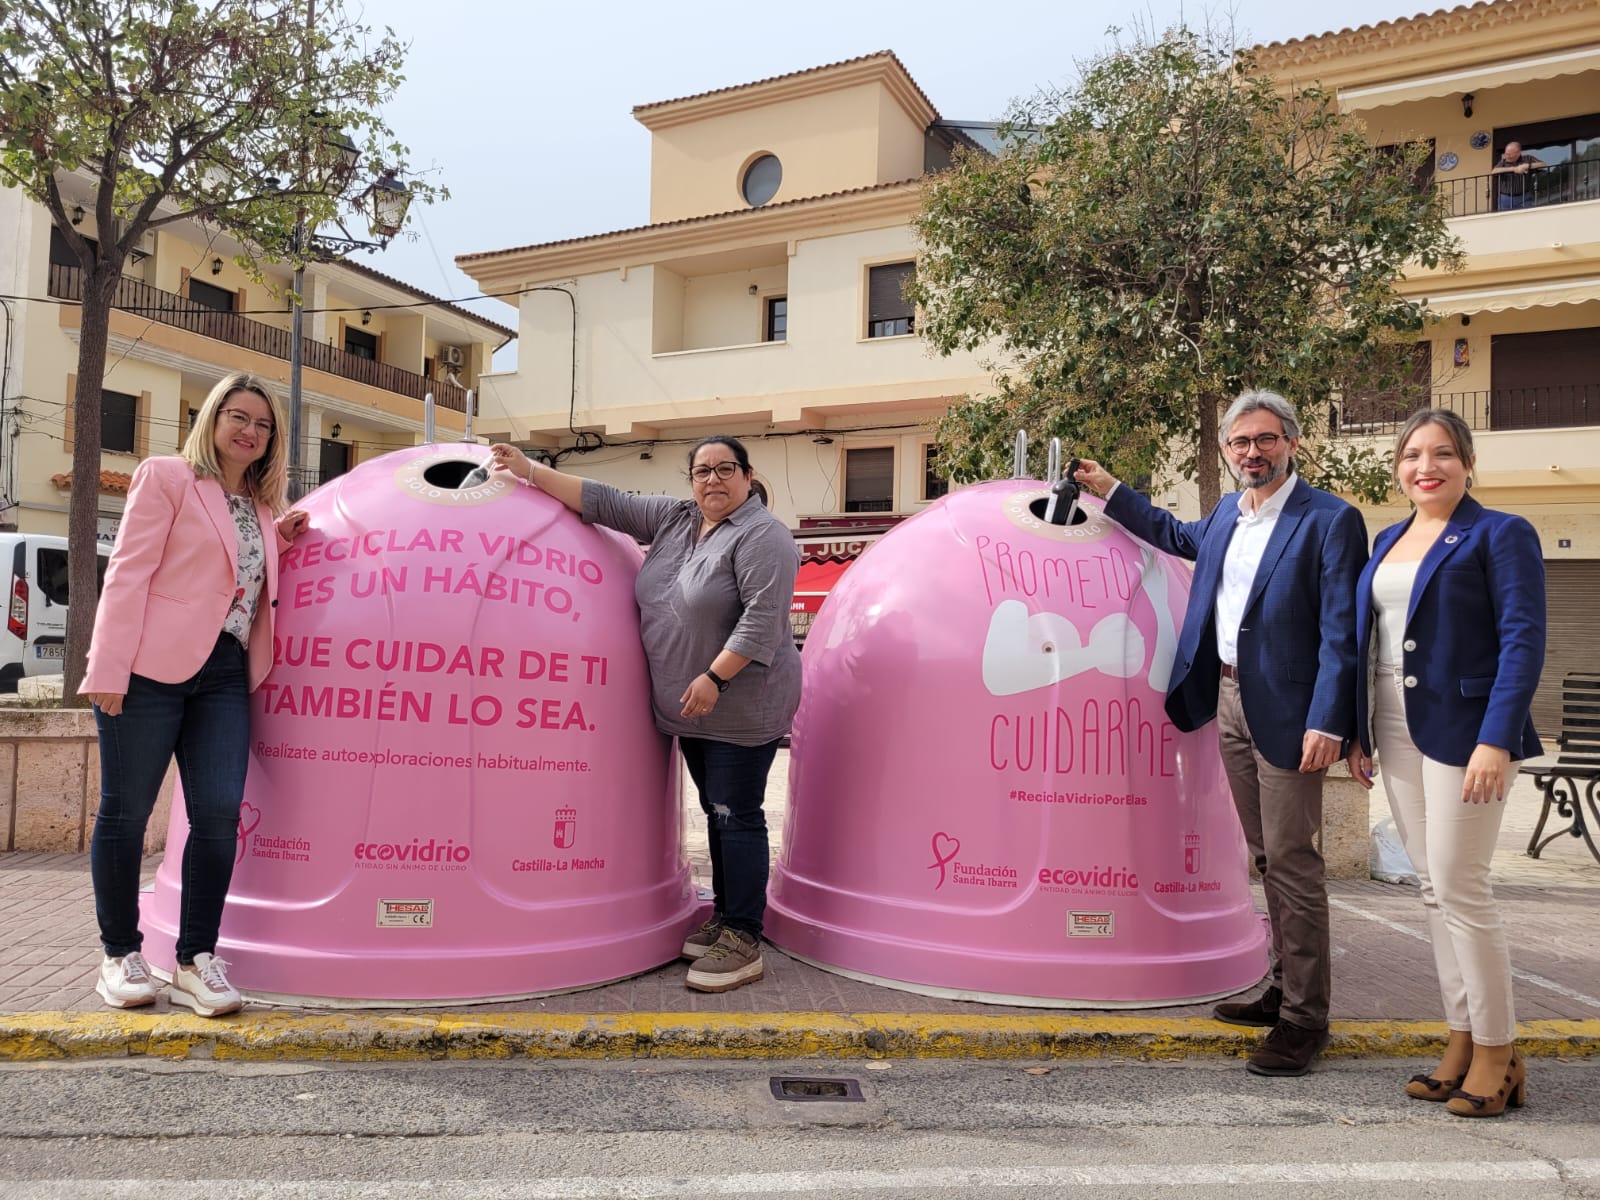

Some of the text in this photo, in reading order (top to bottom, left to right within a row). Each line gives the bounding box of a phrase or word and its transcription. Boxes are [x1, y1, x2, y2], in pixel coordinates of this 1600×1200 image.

[407, 477, 506, 501] SOLO VIDRIO
[1064, 525, 1100, 536] SOLO
[280, 529, 603, 585] RECICLAR VIDRIO
[976, 535, 1132, 608] PROMETO
[294, 563, 581, 622] ES UN HÁBITO,
[345, 638, 505, 677] CUIDAR
[518, 650, 569, 682] DE
[581, 655, 608, 686] TI
[260, 682, 596, 732] TAMBIÉN LO SEA.
[989, 697, 1175, 776] CUIDARME
[256, 741, 592, 773] Realízate autoexploraciones habitualmente.
[252, 847, 310, 861] Sandra Ibarra
[253, 834, 311, 851] Fundación
[354, 838, 471, 862] ecovidrio
[512, 857, 605, 871] Castilla-La Mancha
[953, 862, 1017, 878] Fundación
[953, 875, 1017, 888] Sandra Ibarra
[1038, 865, 1139, 888] ecovidrio
